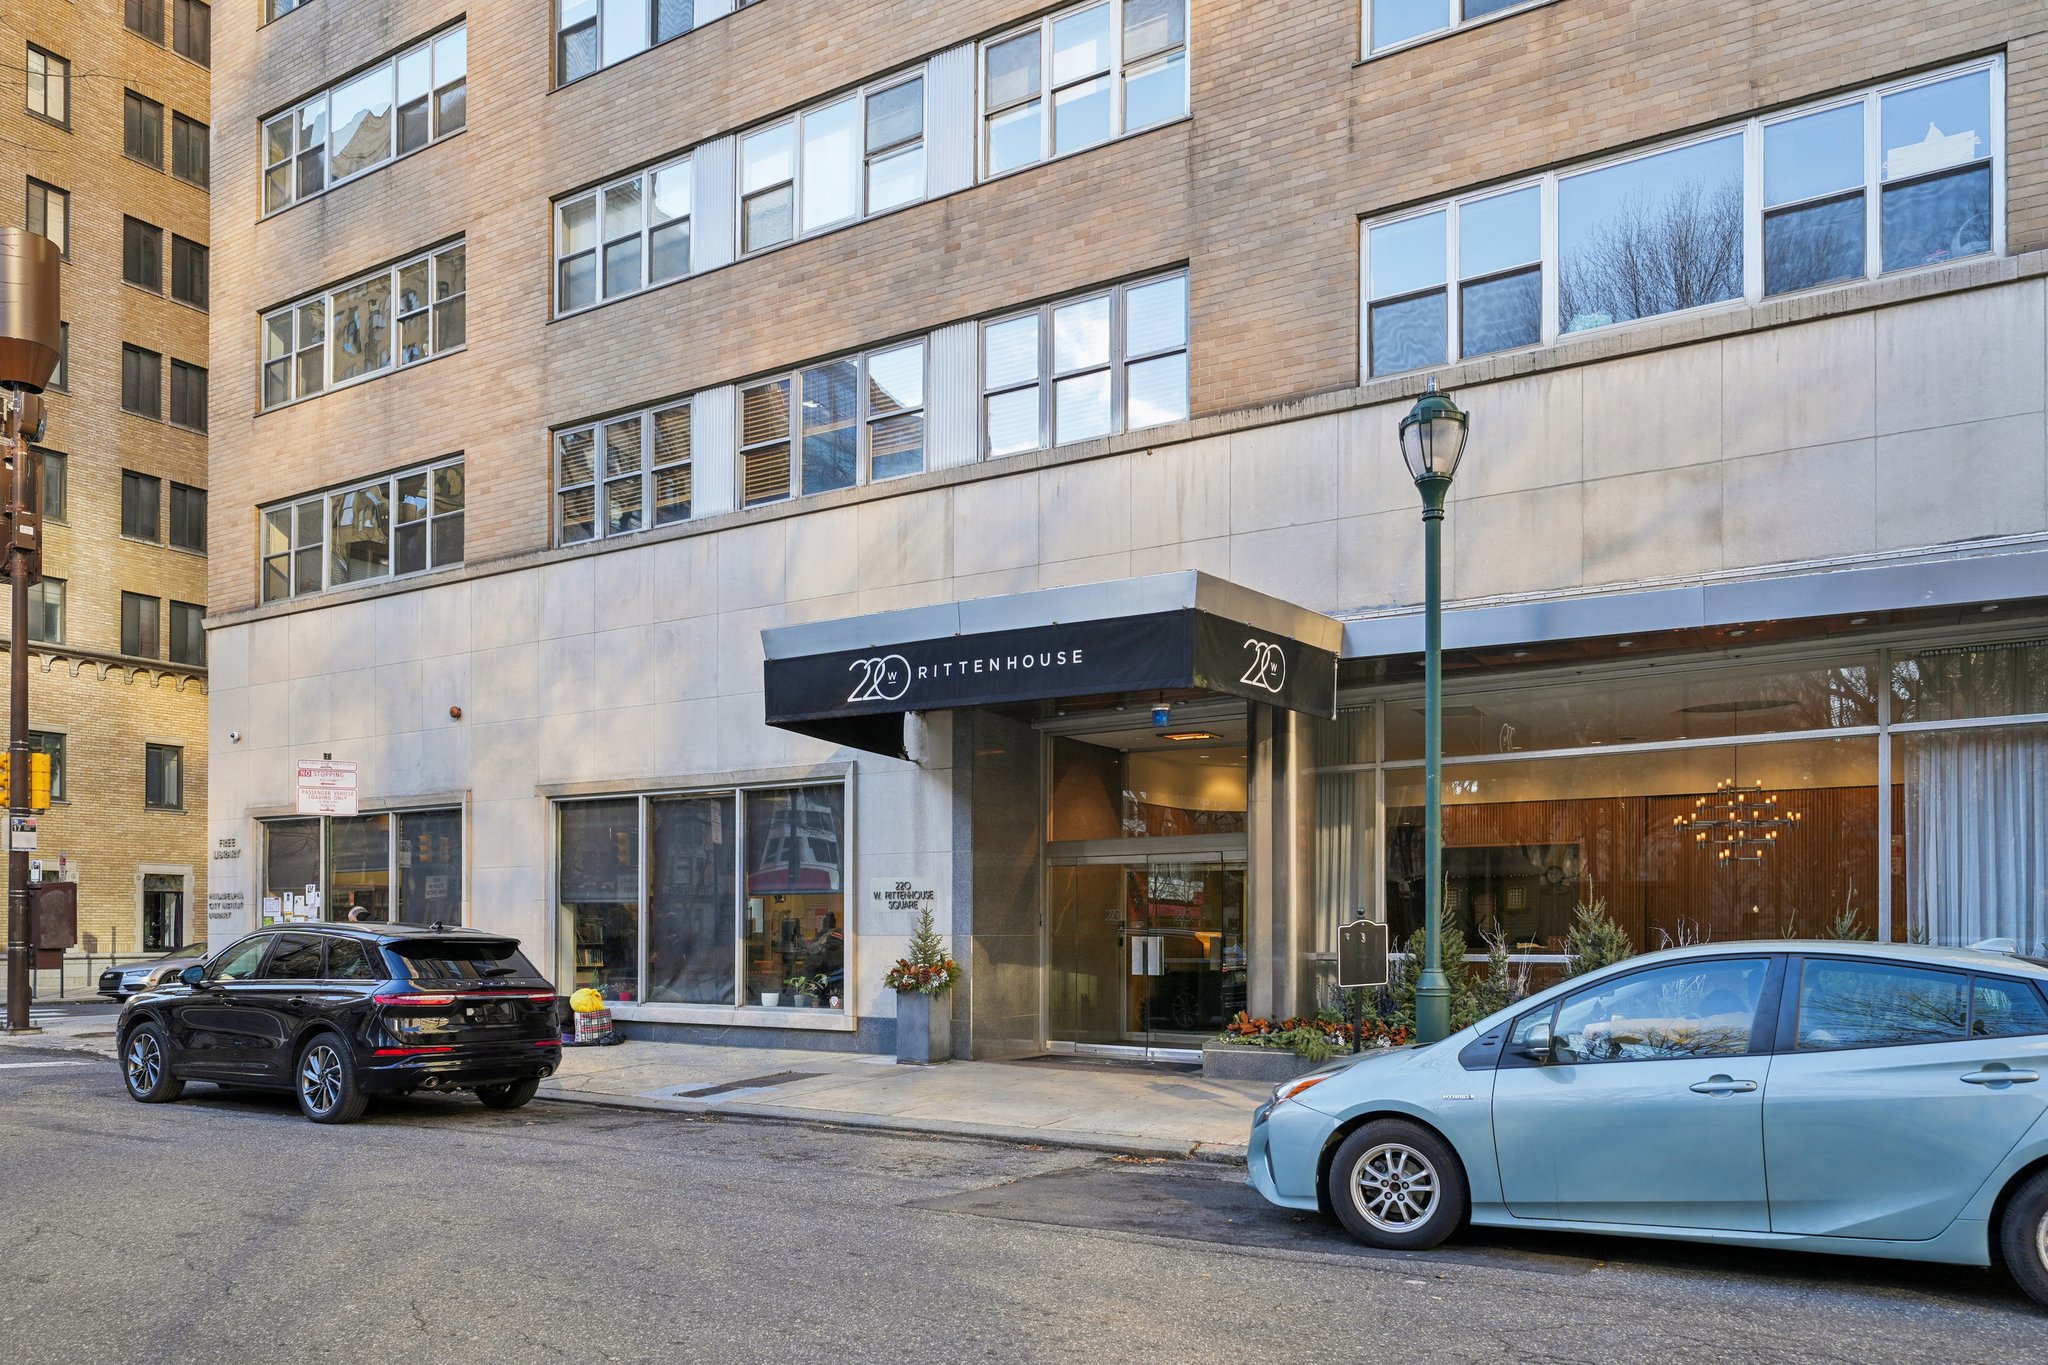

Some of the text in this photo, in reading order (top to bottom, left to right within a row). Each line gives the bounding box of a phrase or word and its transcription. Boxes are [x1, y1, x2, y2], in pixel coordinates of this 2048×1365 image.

[1240, 639, 1286, 693] 220
[1270, 662, 1278, 673] W
[847, 650, 1083, 702] 220 RITTENHOUSE
[888, 671, 898, 681] W
[219, 838, 236, 848] FREE
[213, 849, 241, 860] LIBRARY
[895, 881, 912, 890] 220
[873, 890, 934, 900] W. RITTENHOUSE
[888, 900, 918, 910] SQUARE
